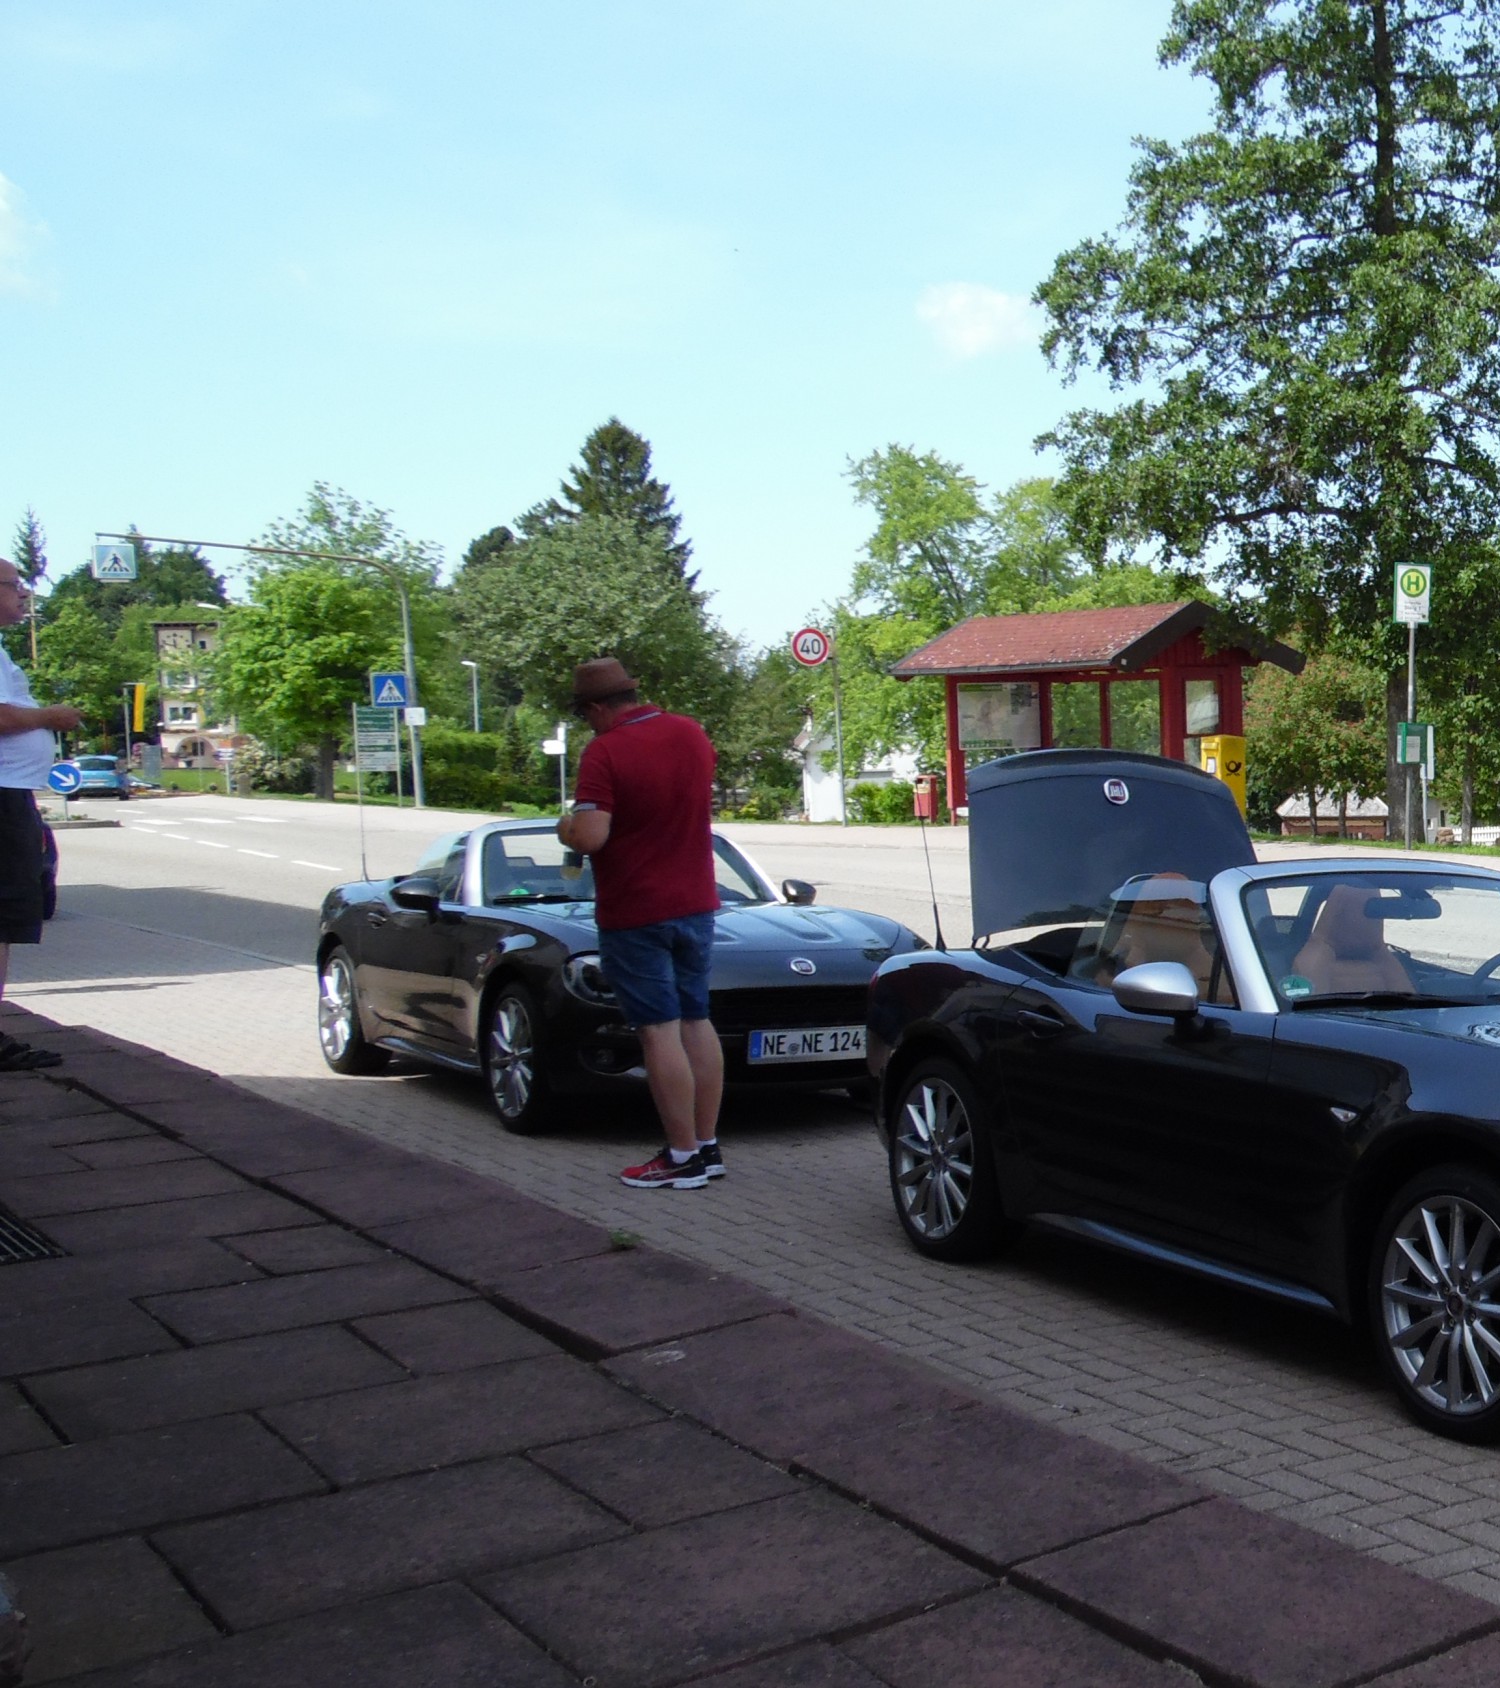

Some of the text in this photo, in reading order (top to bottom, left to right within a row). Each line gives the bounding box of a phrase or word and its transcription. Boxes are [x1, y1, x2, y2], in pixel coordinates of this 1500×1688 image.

[1406, 574, 1420, 591] H
[800, 638, 821, 655] 40
[763, 1034, 787, 1055] NE
[801, 1033, 824, 1053] NE
[829, 1031, 861, 1052] 124
